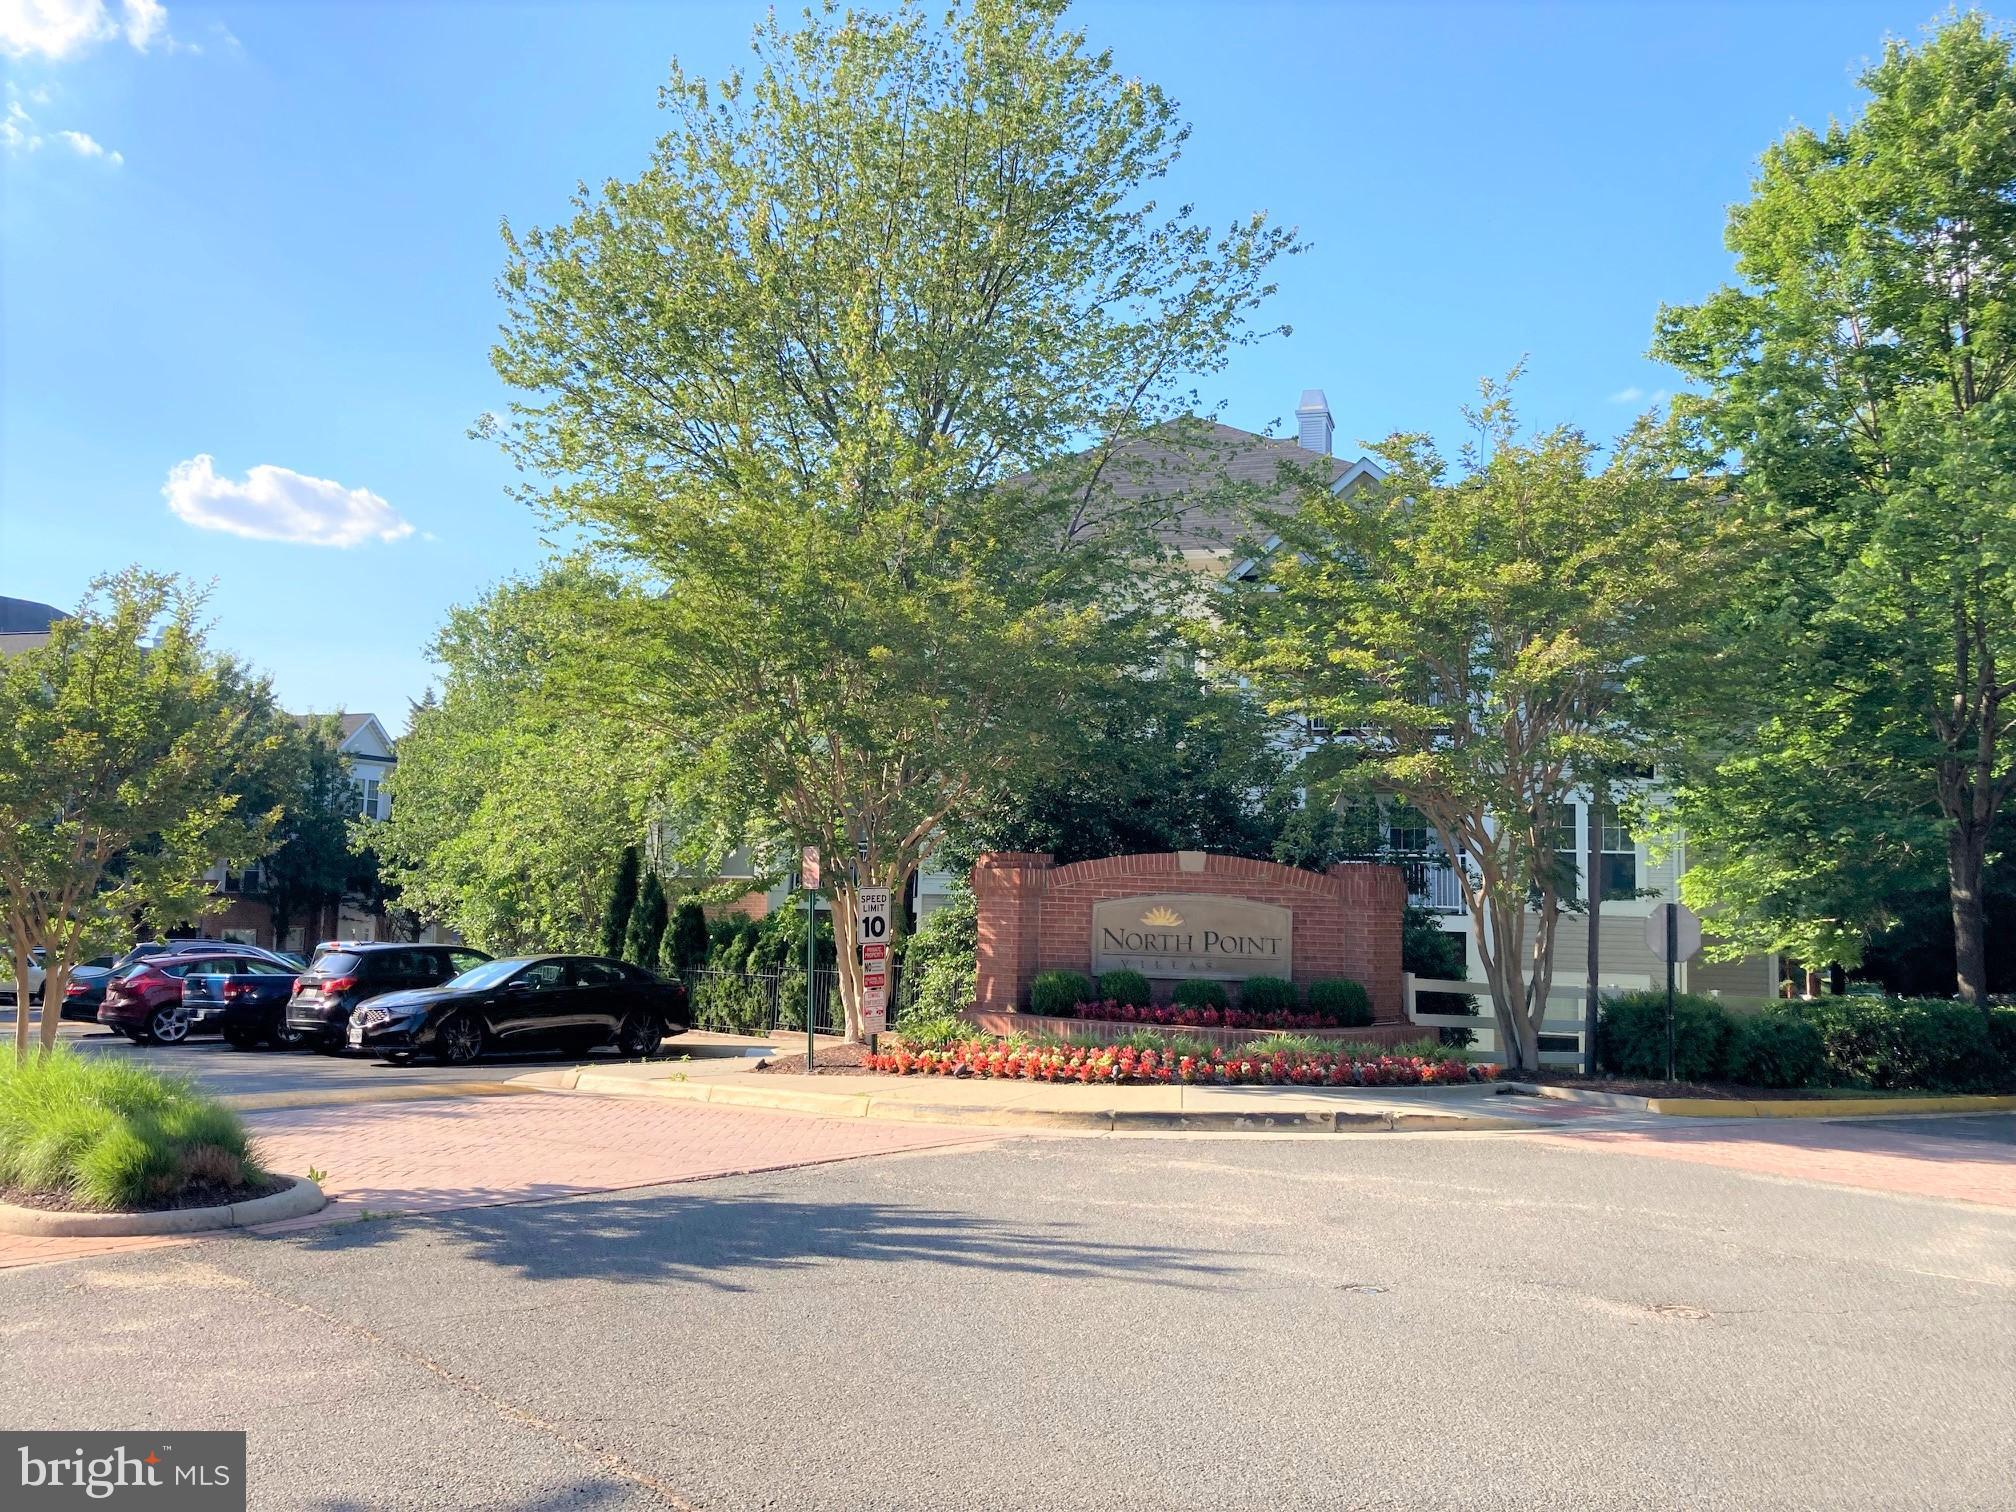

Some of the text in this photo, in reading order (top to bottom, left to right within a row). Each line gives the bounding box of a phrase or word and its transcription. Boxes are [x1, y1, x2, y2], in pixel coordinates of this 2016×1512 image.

[861, 894, 887, 904] SPEED
[863, 904, 884, 912] LIMIT
[862, 916, 885, 938] 10
[1103, 928, 1282, 954] NORTH POINT
[864, 962, 872, 972] NO
[1121, 959, 1216, 969] VILLAS
